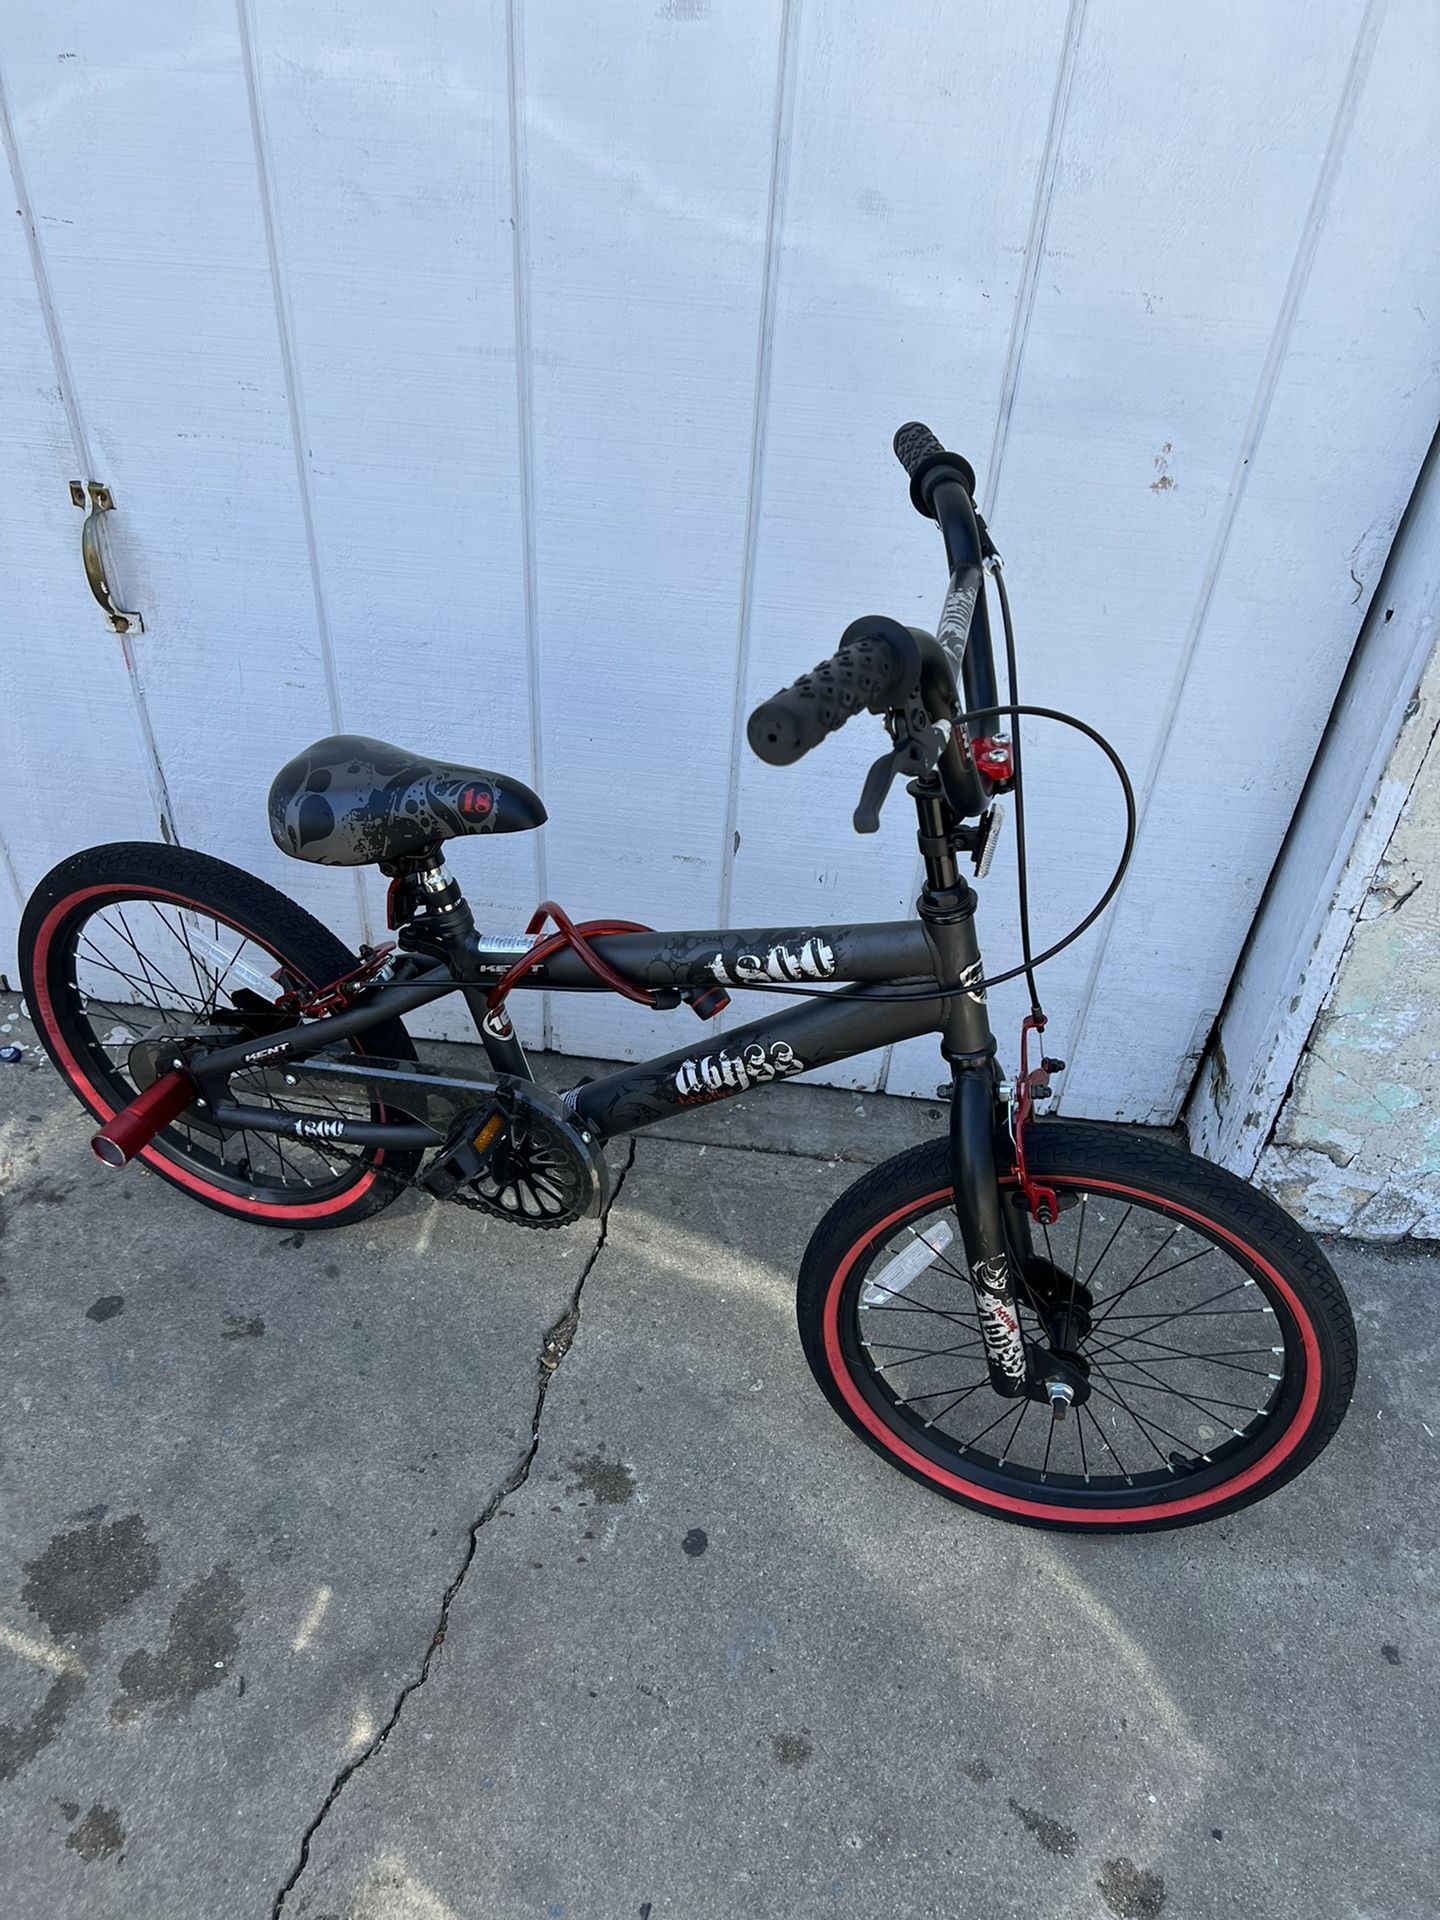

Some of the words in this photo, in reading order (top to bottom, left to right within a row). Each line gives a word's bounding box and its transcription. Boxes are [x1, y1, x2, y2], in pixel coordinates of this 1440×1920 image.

[462, 788, 493, 814] 18
[480, 964, 545, 973] KET
[245, 1042, 290, 1062] KENT
[675, 1041, 804, 1096] abyss
[293, 1119, 345, 1138] 1800
